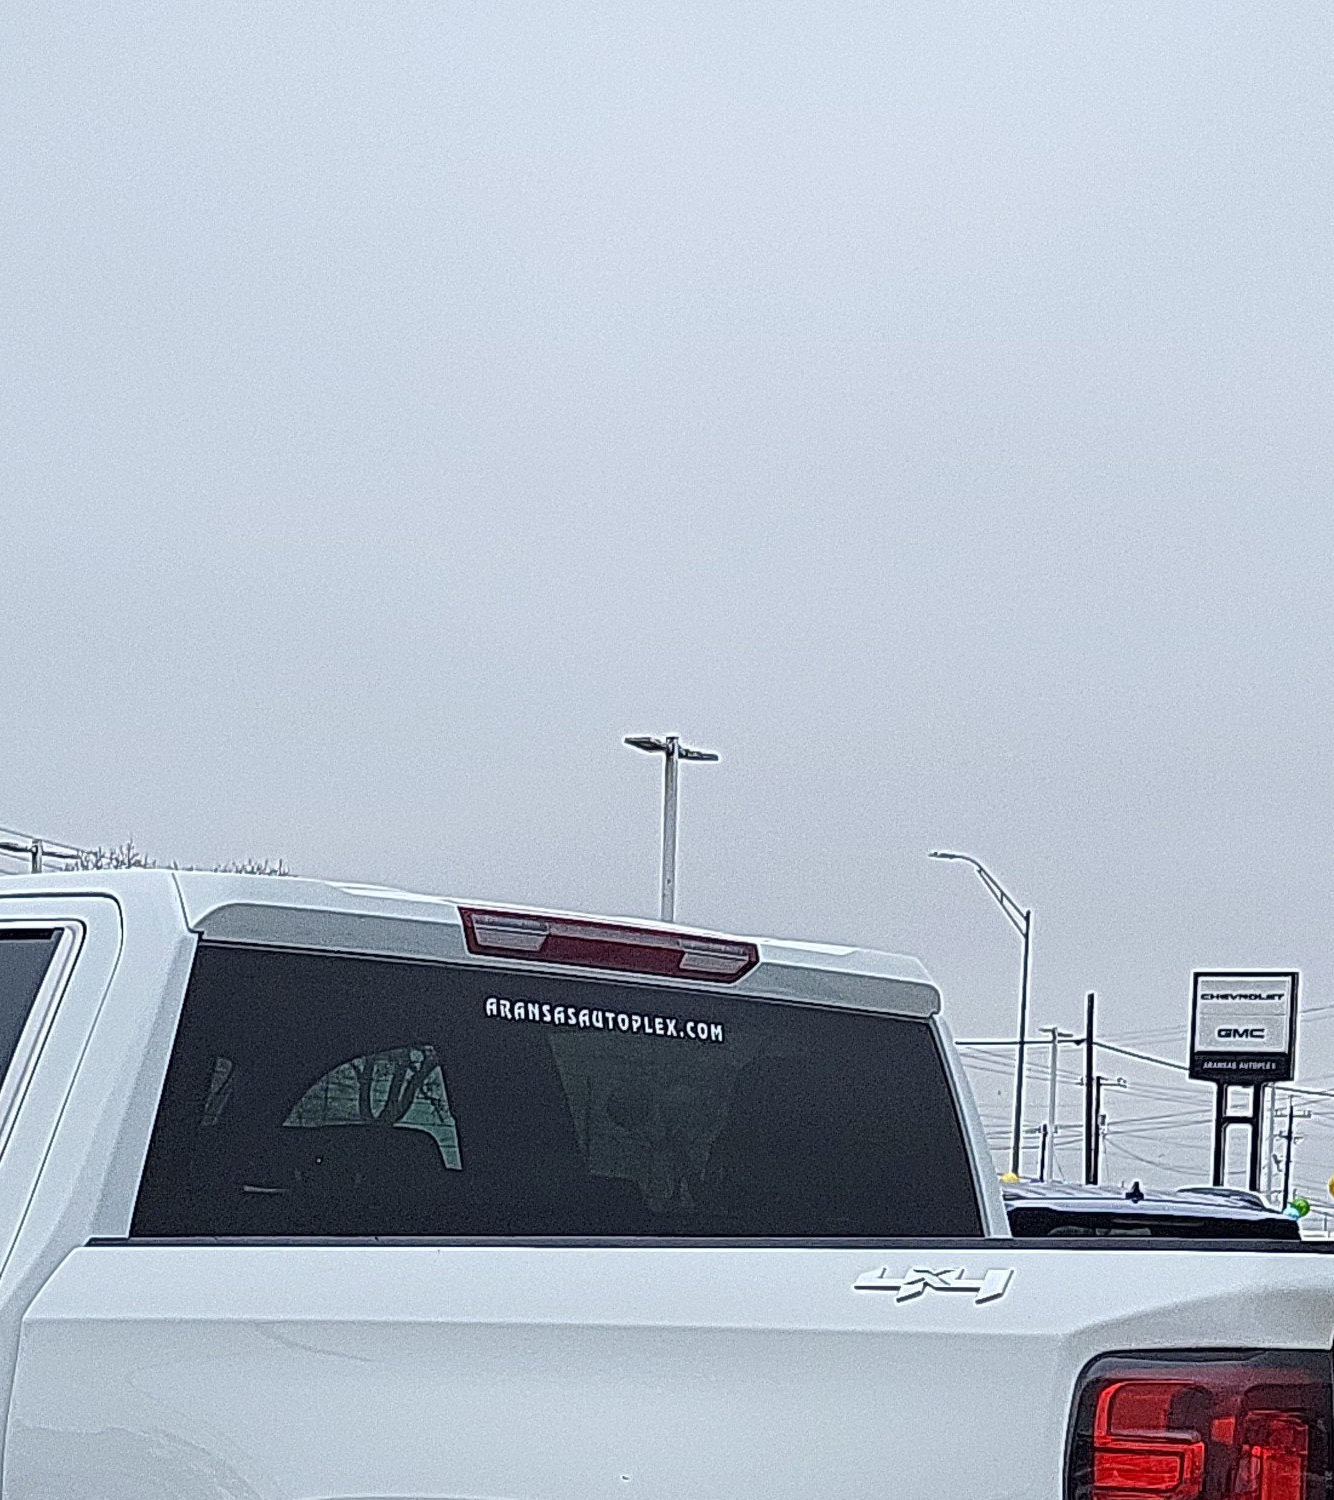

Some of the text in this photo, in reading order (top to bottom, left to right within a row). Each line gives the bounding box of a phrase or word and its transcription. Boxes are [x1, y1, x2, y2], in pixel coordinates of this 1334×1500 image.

[1200, 993, 1285, 1001] CHEVROLET
[485, 998, 724, 1042] ARANSASAUTOPLEX.COM
[1217, 1028, 1265, 1039] GMC
[1202, 1061, 1237, 1070] ARANSAS
